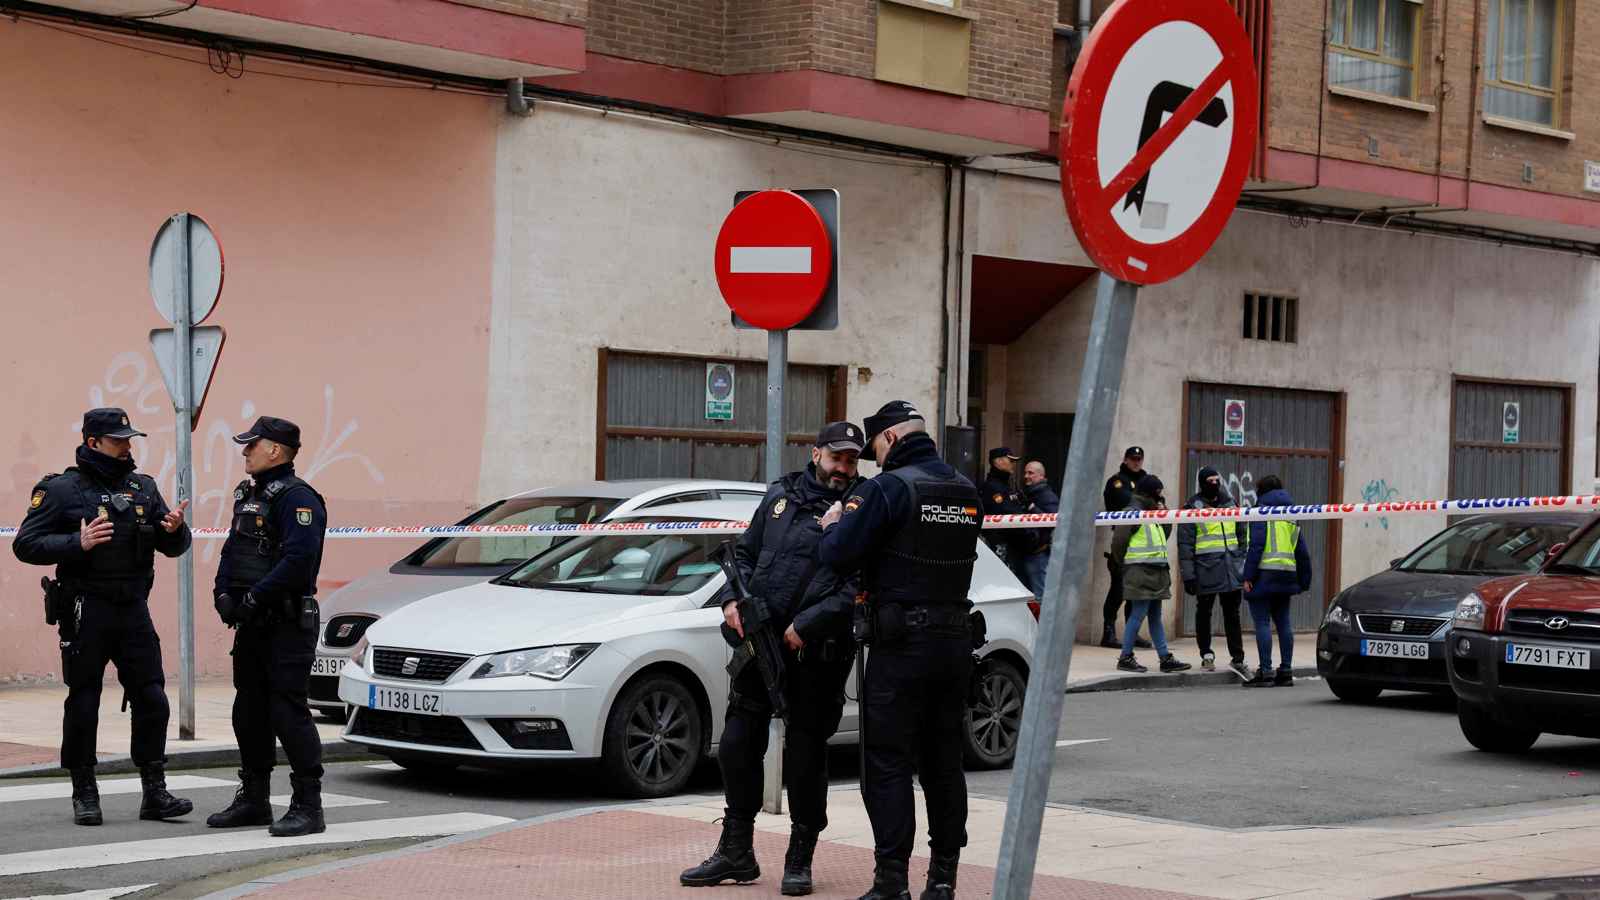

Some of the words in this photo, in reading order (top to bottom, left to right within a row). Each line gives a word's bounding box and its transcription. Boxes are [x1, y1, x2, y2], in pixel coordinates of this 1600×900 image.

[921, 504, 967, 515] POLICIA
[921, 514, 977, 525] NACIONAL
[1369, 641, 1399, 655] 7879
[1402, 643, 1426, 656] LGG
[1515, 647, 1551, 664] 7791
[1557, 650, 1586, 667] FXT
[312, 659, 337, 674] 9619
[380, 690, 410, 710] 1138
